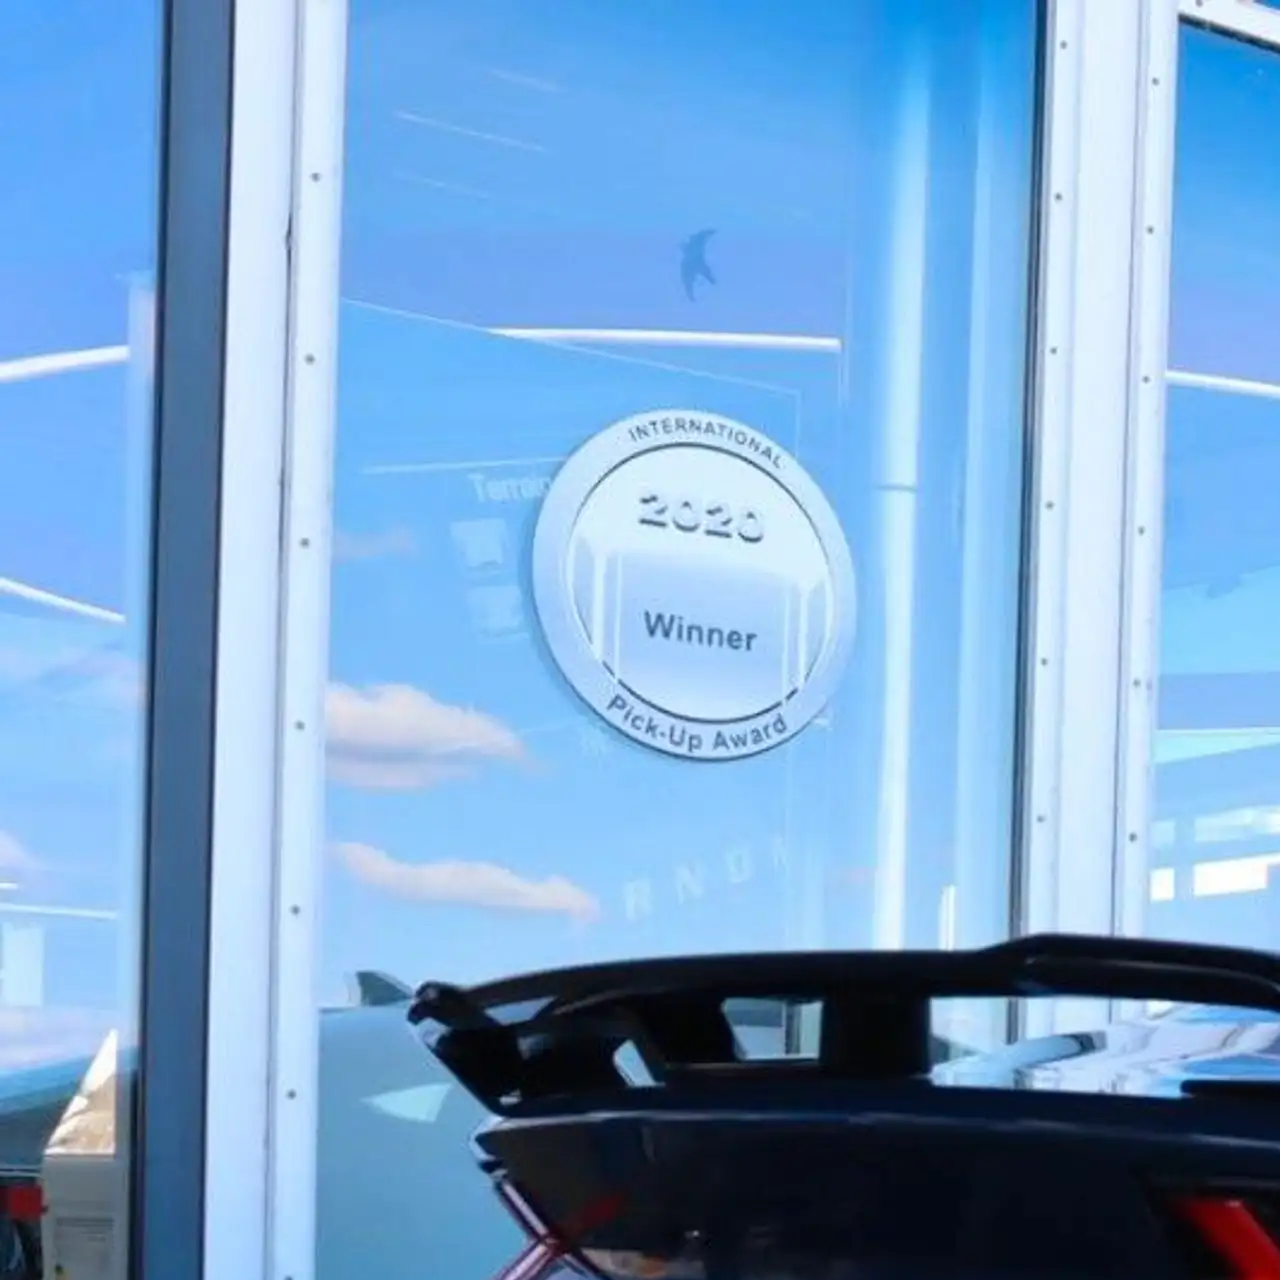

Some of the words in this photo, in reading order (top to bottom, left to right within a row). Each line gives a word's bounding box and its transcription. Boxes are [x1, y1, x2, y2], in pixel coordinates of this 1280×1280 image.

[628, 417, 783, 469] INTERNATIONAL
[638, 493, 765, 544] 2020
[643, 608, 759, 652] Winner
[605, 693, 704, 753] Pick-Up
[712, 711, 788, 751] Award
